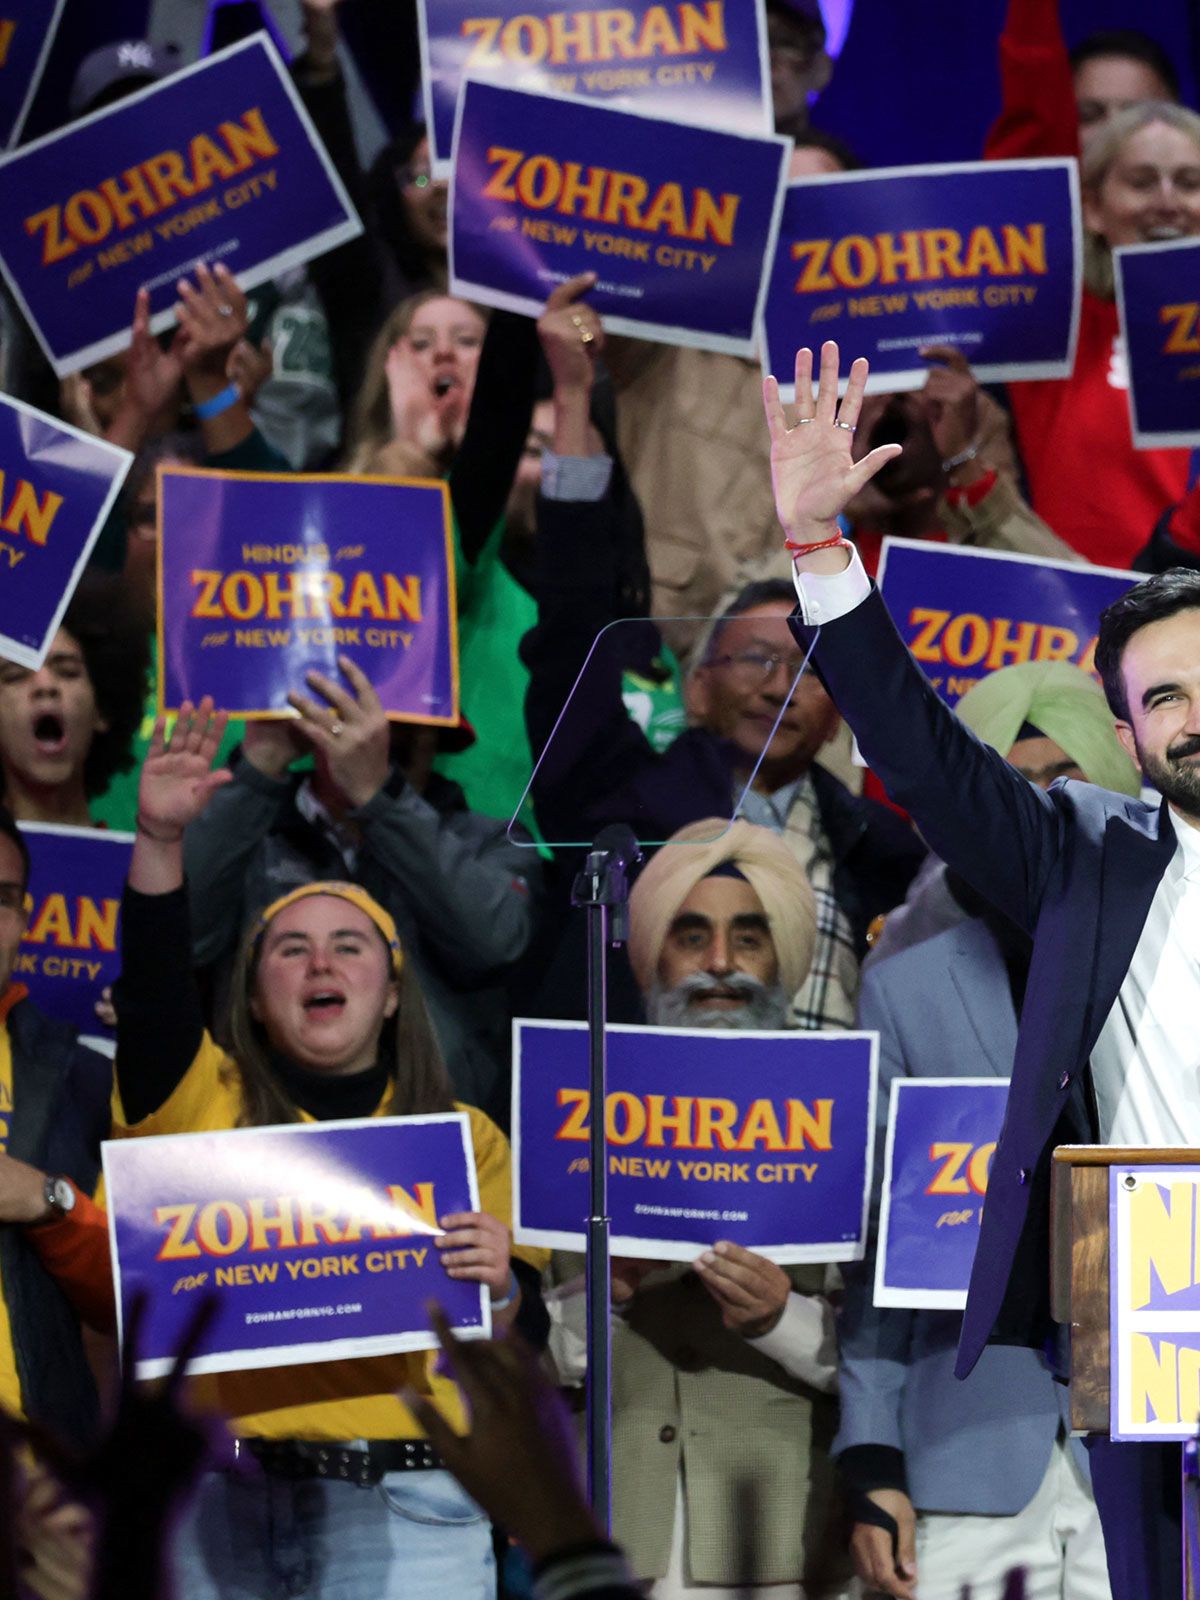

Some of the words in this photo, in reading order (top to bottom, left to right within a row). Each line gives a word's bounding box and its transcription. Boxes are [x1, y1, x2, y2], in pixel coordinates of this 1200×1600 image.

[460, 1, 730, 67] ZOHRAN
[582, 67, 650, 91] YORK
[655, 61, 716, 85] CITY
[24, 106, 280, 267] ZOHRAN
[481, 145, 741, 247] ZOHRAN
[97, 231, 154, 271] NEW
[155, 199, 223, 240] YORK
[223, 169, 278, 210] CITY
[521, 218, 578, 246] NEW
[583, 229, 651, 262] YORK
[655, 245, 718, 274] CITY
[790, 223, 1049, 294] ZOHRAN
[847, 292, 909, 318] NEW
[912, 286, 980, 310] YORK
[983, 284, 1038, 308] CITY
[0, 468, 64, 546] N
[241, 543, 331, 564] HINDUS
[191, 570, 423, 623] ZOHRAN
[234, 628, 292, 647] NEW
[300, 628, 360, 645] YORK
[365, 629, 414, 649] CITY
[42, 956, 102, 981] CITY
[554, 1088, 835, 1151] ZOHRAN
[609, 1156, 672, 1178] NEW
[677, 1160, 750, 1182] YORK
[755, 1163, 818, 1183] CITY
[154, 1182, 438, 1261] ZOHRAN
[215, 1262, 279, 1287] NEW
[285, 1254, 359, 1278] YORK
[365, 1247, 428, 1273] CITY
